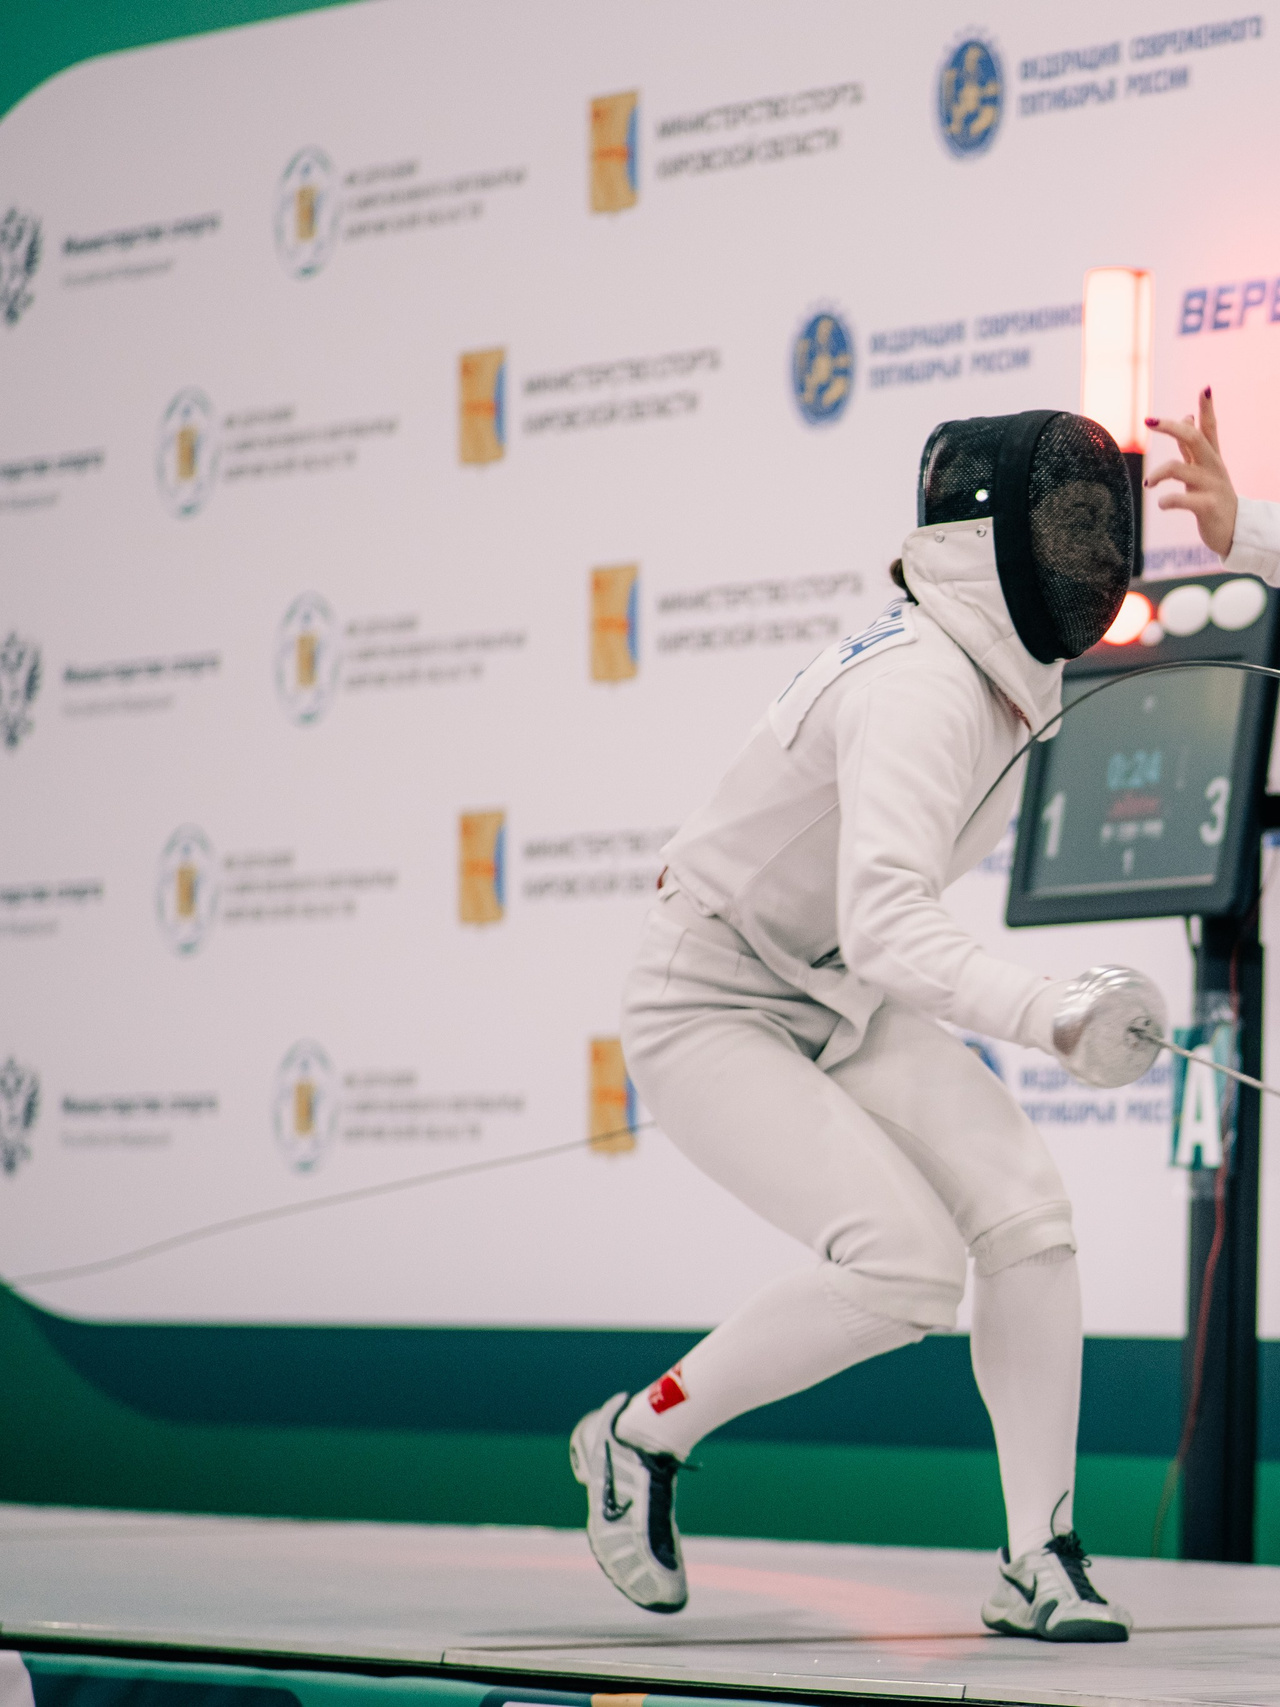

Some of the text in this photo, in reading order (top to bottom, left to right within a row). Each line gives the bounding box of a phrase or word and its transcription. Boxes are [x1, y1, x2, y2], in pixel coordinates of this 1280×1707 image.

[1043, 792, 1066, 861] 1
[1201, 776, 1231, 846] 3
[1176, 1044, 1224, 1168] A
